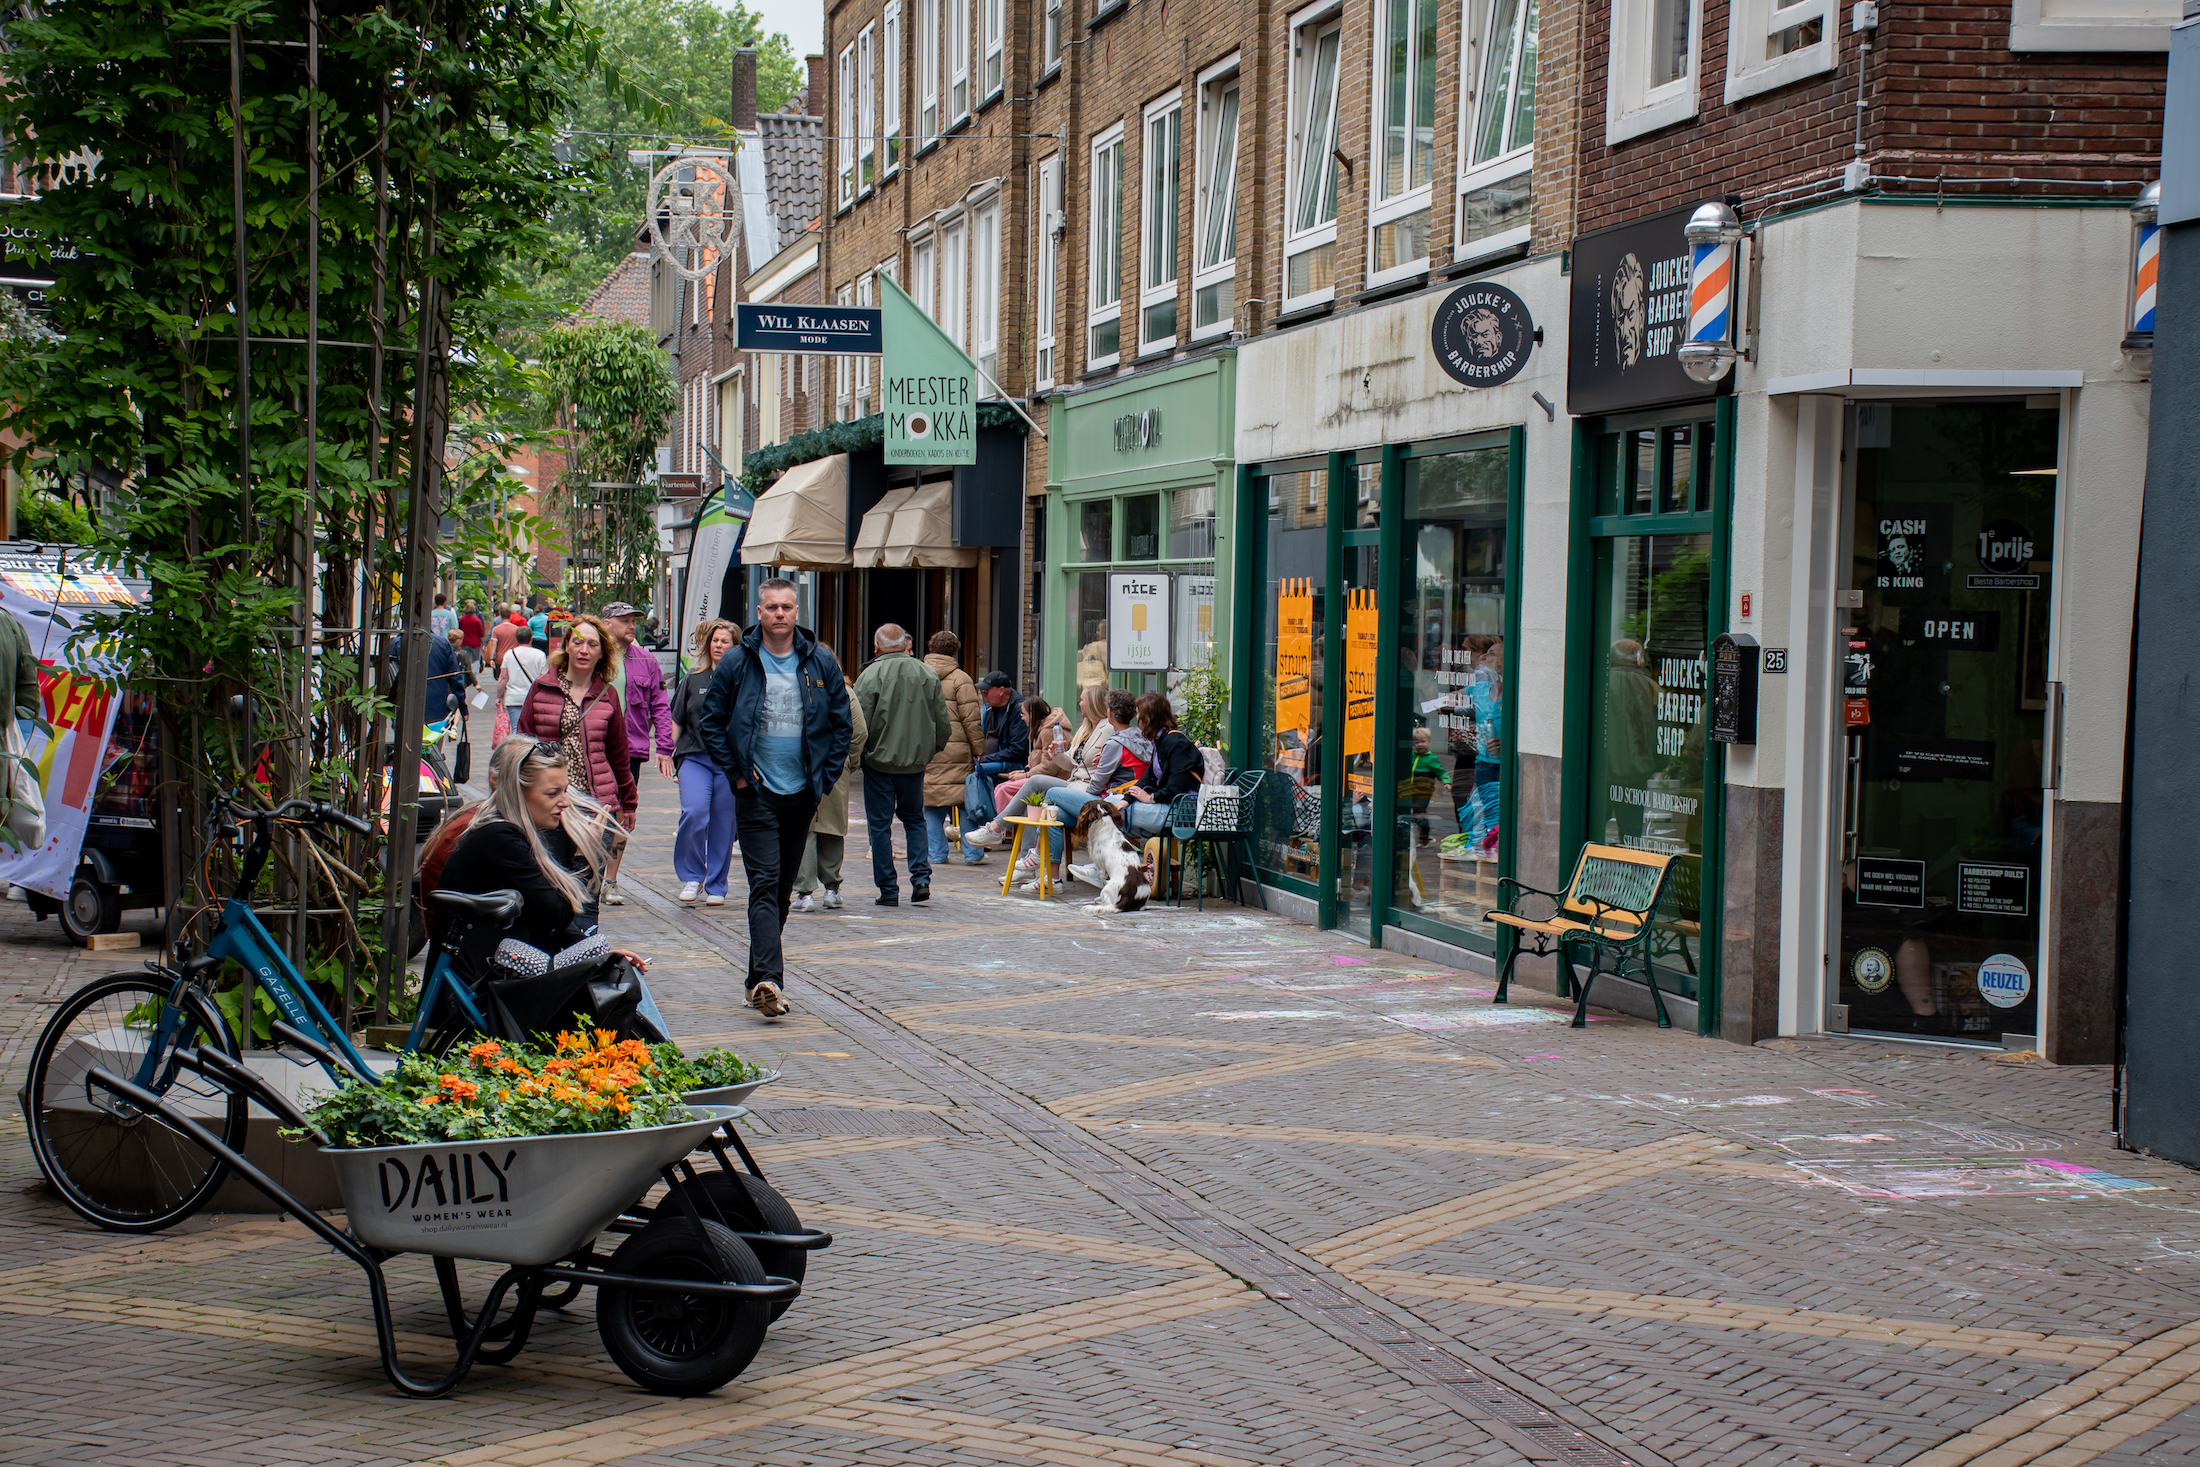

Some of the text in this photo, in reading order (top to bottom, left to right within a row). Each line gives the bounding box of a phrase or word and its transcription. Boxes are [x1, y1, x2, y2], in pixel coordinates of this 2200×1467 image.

[1455, 292, 1512, 314] JOUCKE'S
[757, 314, 870, 331] WIL KLAASEN
[800, 335, 828, 344] MODE
[1646, 325, 1674, 358] SHOP
[1447, 350, 1517, 378] BARBERSHOP
[889, 376, 969, 406] MEESTER
[890, 410, 970, 442] MOKKA
[1880, 519, 1927, 535] CASH
[704, 527, 723, 590] Doetinchem
[1991, 536, 2034, 563] prijs
[1877, 576, 1924, 588] IS KING
[1973, 577, 2035, 587] Beste Barbershop
[1924, 620, 1974, 639] OPEN
[1719, 652, 1737, 660] POST
[1766, 652, 1784, 669] 25
[1844, 687, 1868, 695] SOLD HERE
[1657, 692, 1701, 725] BARBER
[1656, 726, 1685, 757] SHOP
[1609, 784, 1698, 816] OLD SCHOOL BARBERSHOP
[1863, 871, 1872, 879] WE
[1884, 872, 1895, 880] WEL
[1895, 873, 1919, 882] VROUWEN
[1963, 867, 2024, 879] BARBERSHOP RULES
[1861, 883, 1875, 891] MAAR
[1883, 884, 1902, 893] KNIPPEN
[1902, 885, 1909, 893] ZE
[1983, 971, 2025, 991] REUZEL
[259, 966, 308, 1025] GAZELLE
[378, 1149, 517, 1213] DAILY
[412, 1208, 513, 1222] WOMEN'S WEAR
[421, 1221, 508, 1234] shop.dailywomenswear.nl
